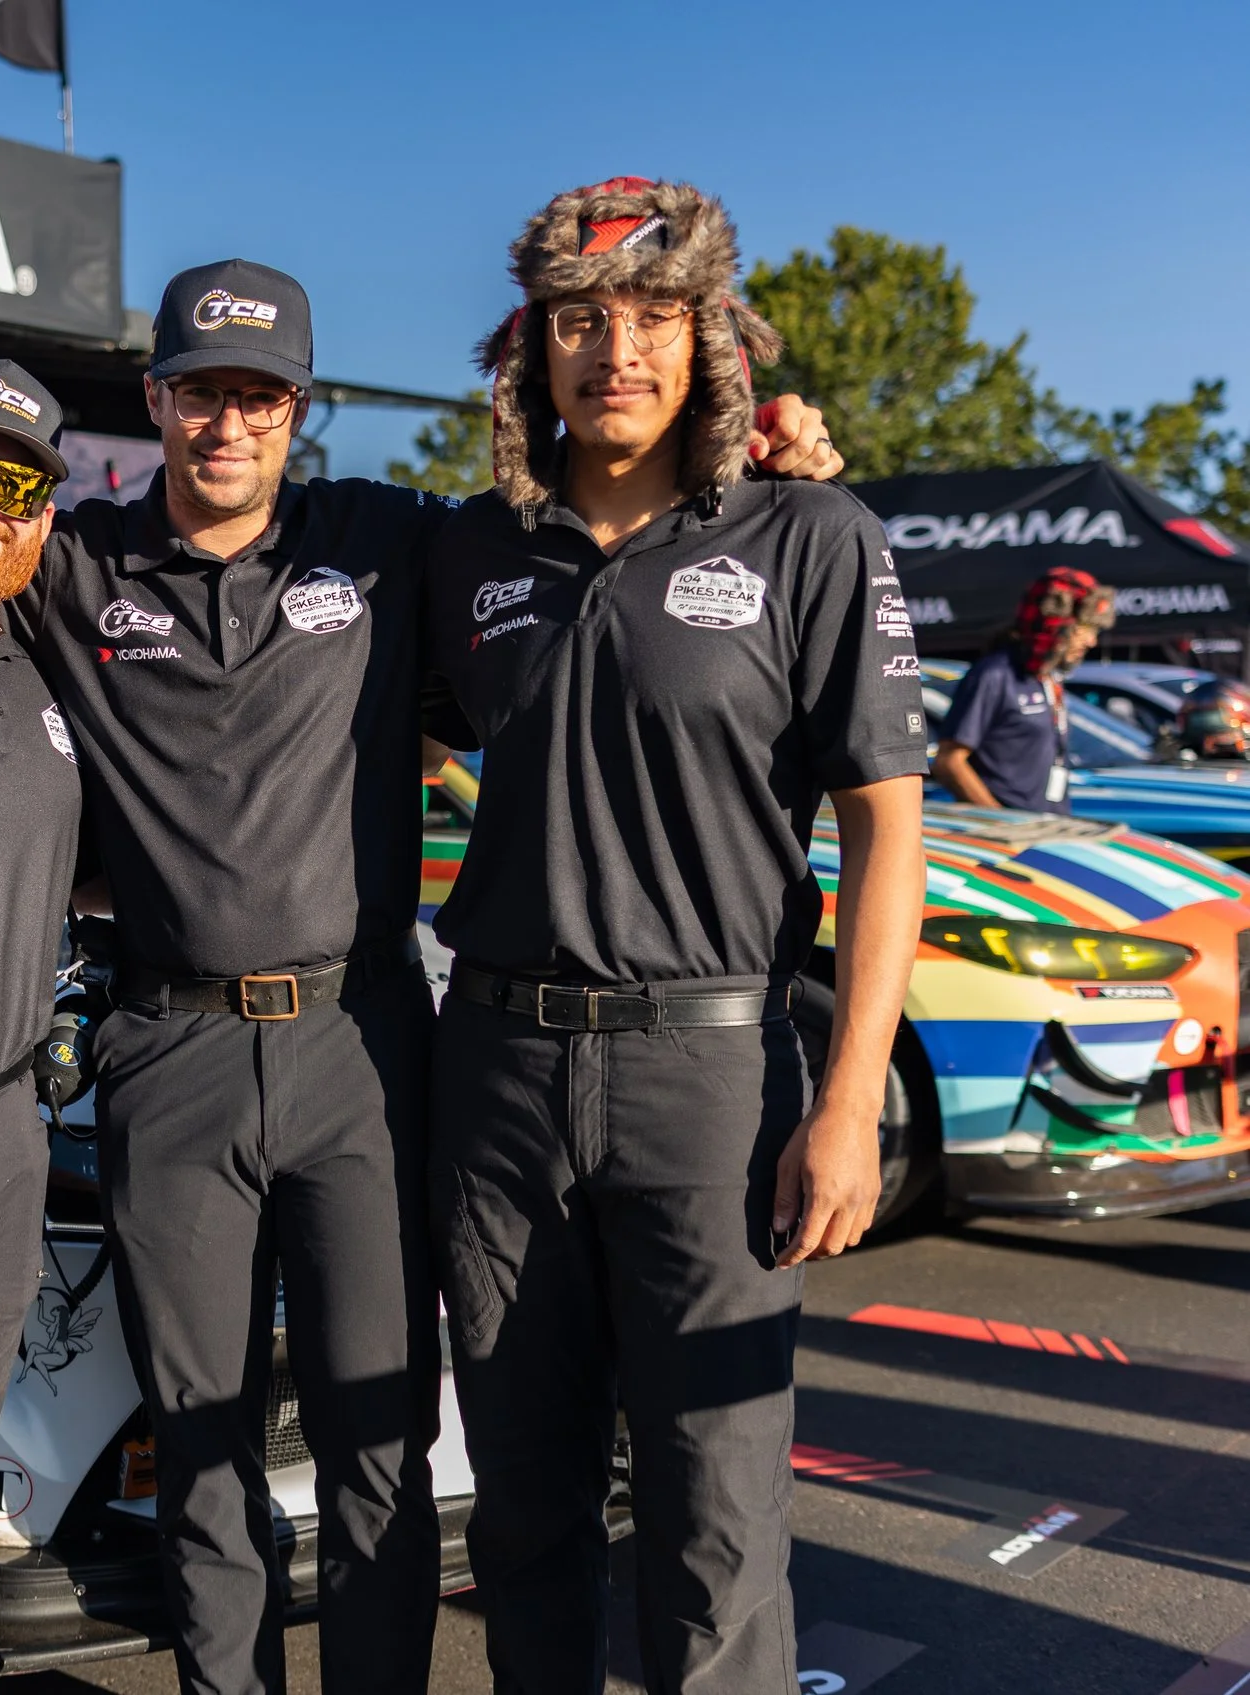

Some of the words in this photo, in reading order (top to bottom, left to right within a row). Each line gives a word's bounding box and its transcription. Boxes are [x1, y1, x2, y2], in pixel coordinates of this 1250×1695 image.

[208, 301, 277, 321] TCB
[231, 317, 273, 330] RACING
[1, 403, 38, 424] RACING
[679, 574, 701, 584] 104
[288, 590, 306, 603] 104
[483, 578, 534, 608] TCB
[497, 593, 530, 610] RACING
[673, 585, 714, 597] PIKES
[717, 589, 756, 602] PEAK
[288, 595, 323, 612] PIKES
[113, 610, 174, 630] TCB
[482, 613, 537, 642] YOKOHAMA
[131, 624, 170, 637] RACING
[116, 646, 180, 660] YOKOHAMA
